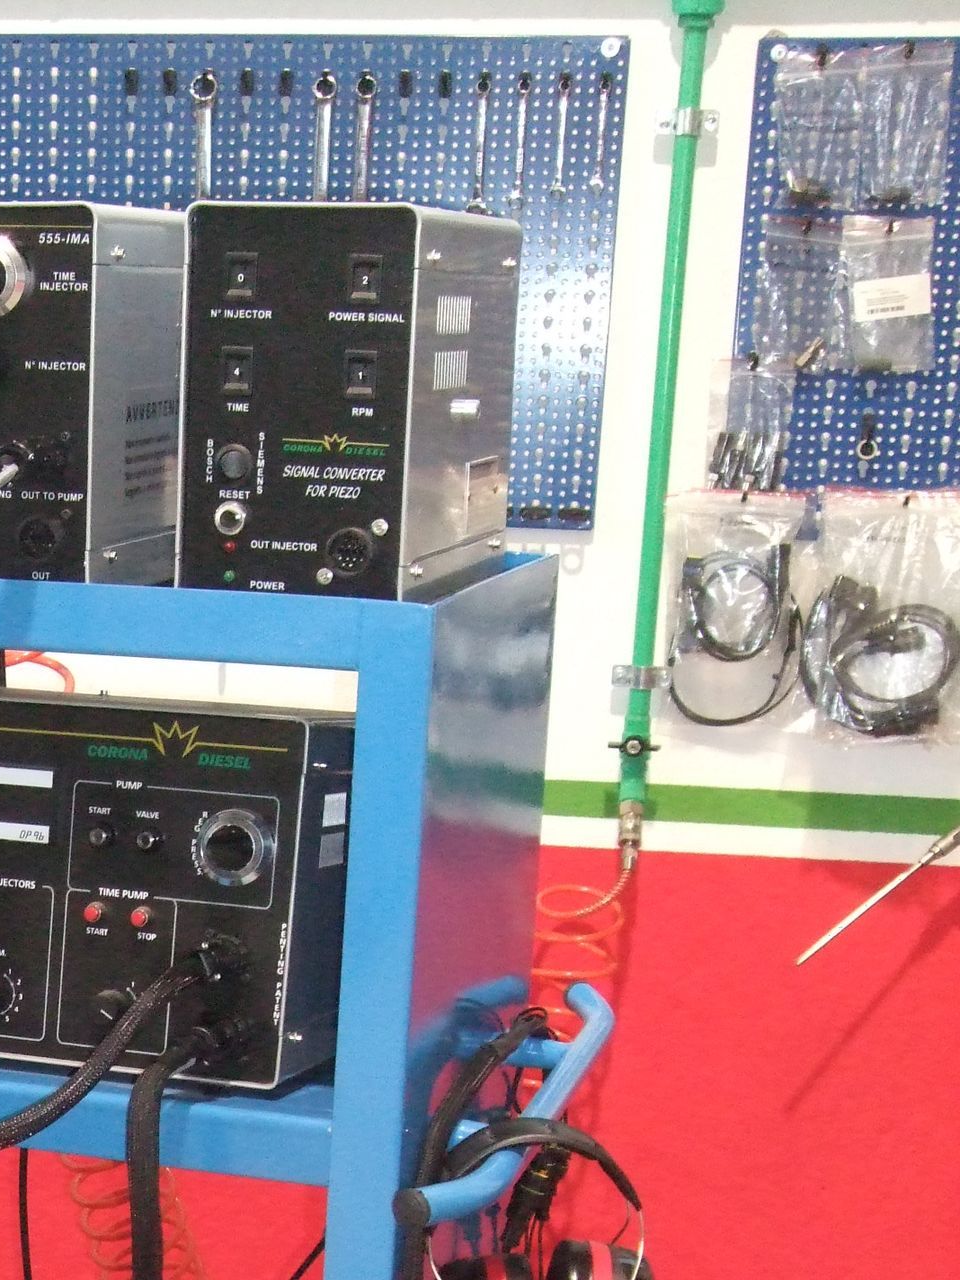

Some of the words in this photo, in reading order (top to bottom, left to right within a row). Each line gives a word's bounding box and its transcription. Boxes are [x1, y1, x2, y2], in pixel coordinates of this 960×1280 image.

[39, 232, 90, 245] 555-IMA
[53, 271, 76, 281] TIME
[237, 274, 244, 282] 0
[362, 276, 368, 285] 2
[40, 282, 88, 292] INJECTOR
[224, 309, 272, 319] INJECTOR
[328, 312, 365, 322] POWER
[368, 313, 405, 323] SIGNAL
[38, 361, 86, 371] INJECTOR
[234, 367, 240, 375] 4
[358, 371, 363, 379] 1
[227, 403, 250, 412] TIME
[351, 407, 373, 417] RPM
[206, 439, 214, 483] BOSCH
[256, 432, 265, 494] SIEMENS
[282, 465, 320, 478] SIGNAL
[323, 466, 386, 481] CONVERTER
[21, 491, 40, 500] OUT
[43, 492, 55, 501] TO
[57, 492, 84, 502] PUMP
[219, 489, 251, 499] RESET
[305, 485, 326, 497] FOR
[328, 485, 361, 498] PIEZO
[250, 540, 269, 549] OUT
[271, 541, 318, 551] INJECTOR
[31, 571, 50, 580] OUT
[250, 580, 285, 591] POWER
[87, 744, 149, 761] CORONA
[197, 752, 252, 770] DIESEL
[116, 780, 143, 790] PUMP
[88, 806, 111, 815] START
[136, 810, 160, 820] VALVE
[99, 887, 120, 898] TIME
[122, 889, 149, 900] PUMP
[86, 927, 109, 937] START
[137, 932, 157, 941] STOP
[276, 923, 287, 976] PENTING
[272, 982, 282, 1026] PATENT
